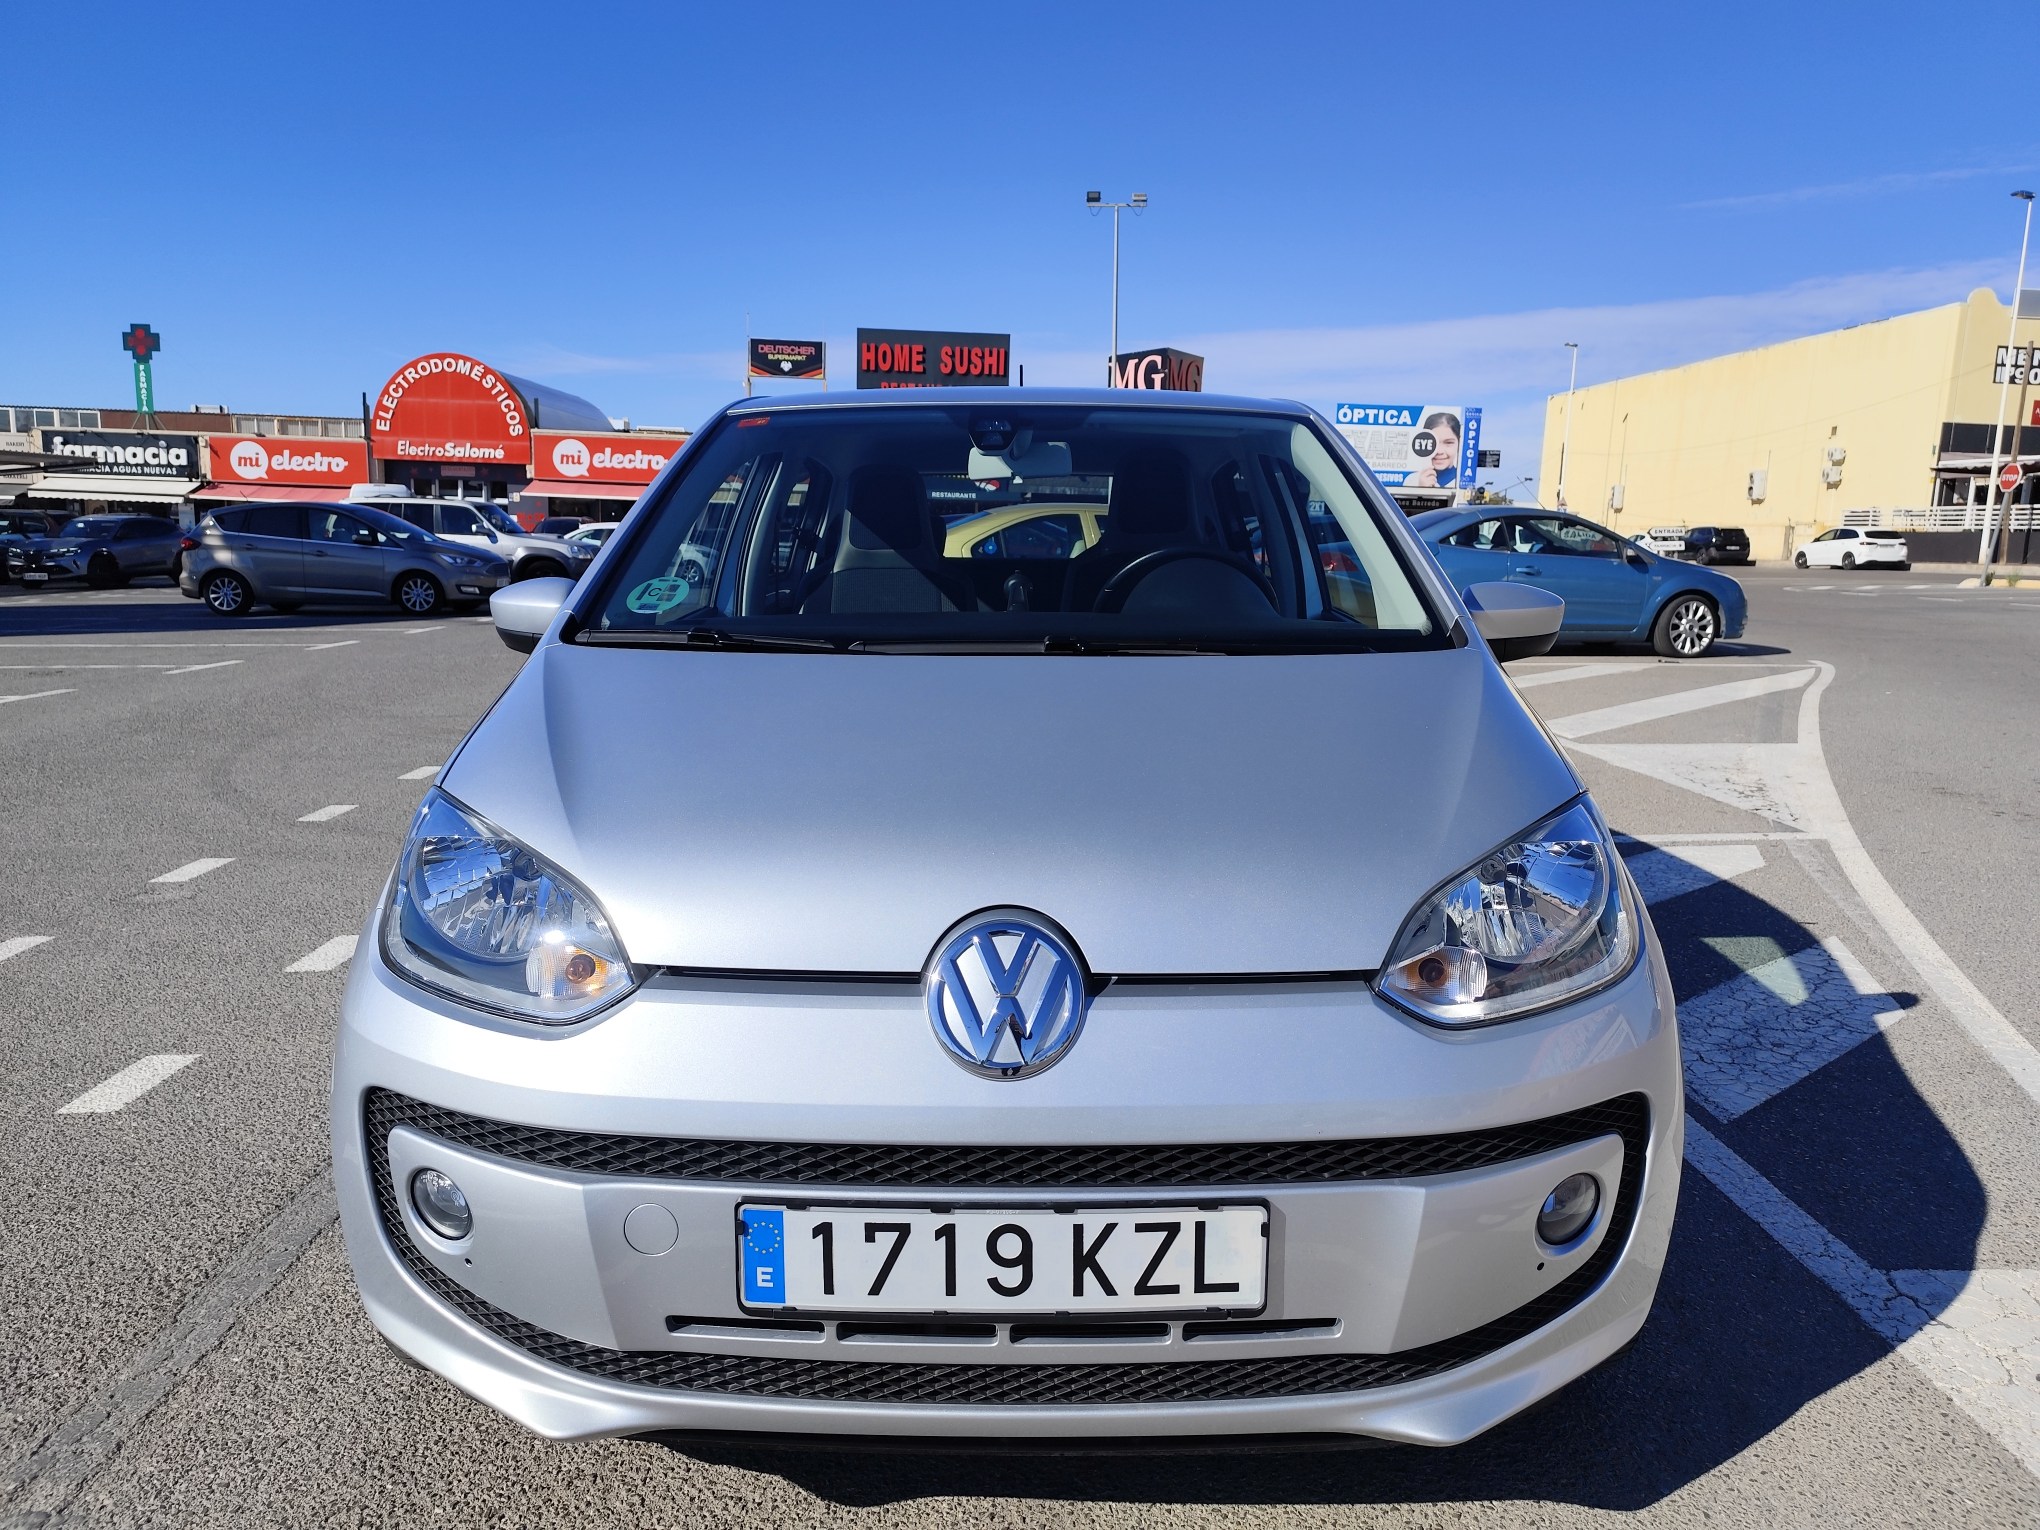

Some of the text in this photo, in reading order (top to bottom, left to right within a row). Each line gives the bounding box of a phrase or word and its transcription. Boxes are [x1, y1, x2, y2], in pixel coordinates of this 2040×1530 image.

[758, 344, 815, 355] DEUTSCHER
[767, 353, 807, 361] SUPERMARKT
[861, 342, 1006, 375] HOME SUSHI
[1108, 354, 1165, 390] MG
[1169, 354, 1201, 392] MG
[139, 364, 149, 412] FARMACIA
[376, 356, 524, 437] ELECTRODOMÉSTICOS
[1337, 404, 1413, 425] ÓPTICA
[51, 435, 188, 466] farmacia
[397, 440, 505, 460] ElectroSalomé
[1414, 438, 1434, 451] EYE
[237, 449, 348, 473] mi electro
[560, 448, 668, 470] mi electro
[1371, 461, 1407, 469] BARREDO
[112, 466, 142, 475] AGUAS
[143, 467, 178, 475] NUEVAS
[2001, 473, 2018, 482] STOP
[931, 491, 977, 499] RESTAURANTE
[1563, 530, 1597, 540] SALIDA
[647, 587, 662, 597] C
[811, 1220, 1240, 1298] 1719 KZL
[755, 1266, 775, 1288] E
